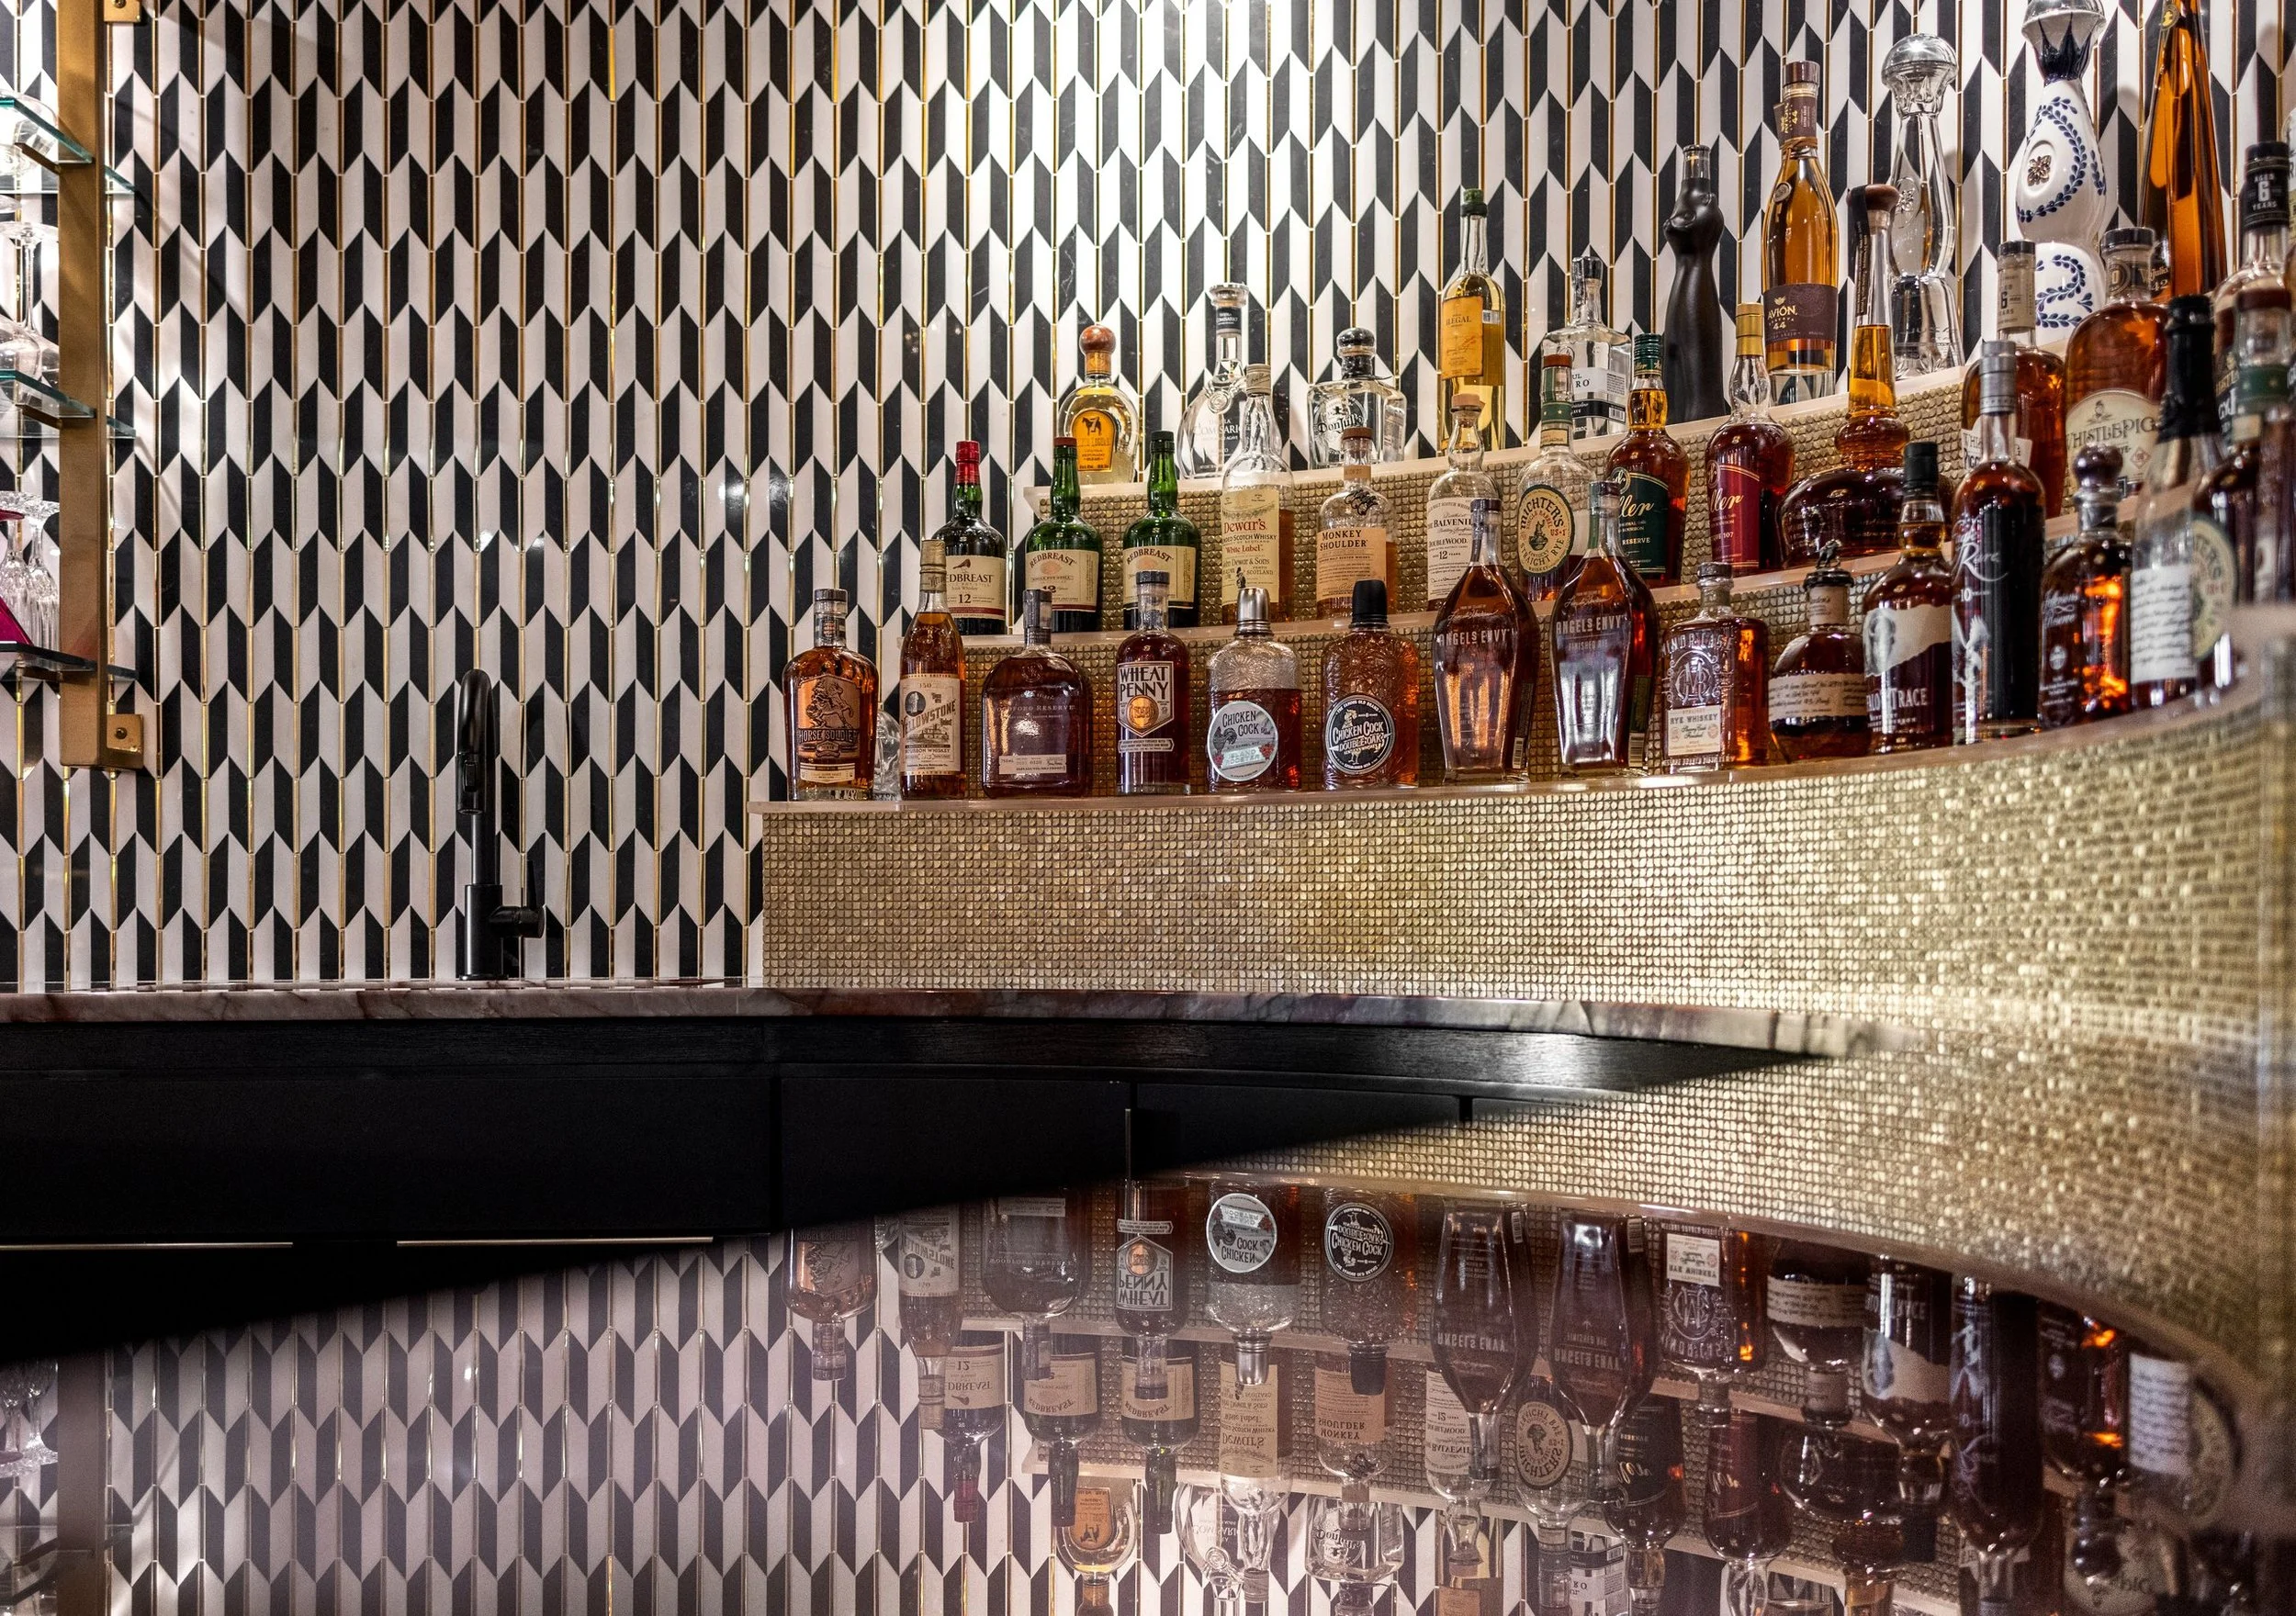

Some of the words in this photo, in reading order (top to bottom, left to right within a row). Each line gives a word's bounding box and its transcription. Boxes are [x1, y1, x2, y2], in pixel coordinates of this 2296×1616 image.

[2258, 181, 2270, 202] 6
[1224, 518, 1266, 534] Dewar's
[1322, 530, 1362, 542] MONKEY
[1320, 539, 1367, 551] SHOULDER
[1521, 543, 1550, 567] STRAIGHT
[1551, 538, 1565, 556] RYE
[1030, 552, 1075, 569] REDBREAST
[1127, 548, 1172, 565] REDBREAST
[1439, 551, 1447, 560] 12
[946, 574, 994, 584] EDBREAST
[959, 594, 972, 604] 12
[1961, 589, 1972, 602] 10
[1556, 618, 1593, 634] ANGELS
[1596, 614, 1622, 631] ENVY
[1438, 632, 1478, 646] ANGELS
[1480, 628, 1508, 644] ENVY
[1120, 667, 1168, 682] WHEAT
[1120, 681, 1169, 702] PENNY
[901, 699, 958, 739] YELLOWSTONE
[1222, 711, 1256, 727] CHICKEN
[1670, 716, 1684, 725] RYE
[1687, 713, 1719, 723] WHISKEY
[799, 729, 821, 744] HORSE
[1237, 724, 1259, 737] COCK
[1333, 723, 1363, 745] CHICKEN
[1363, 721, 1384, 735] COCK
